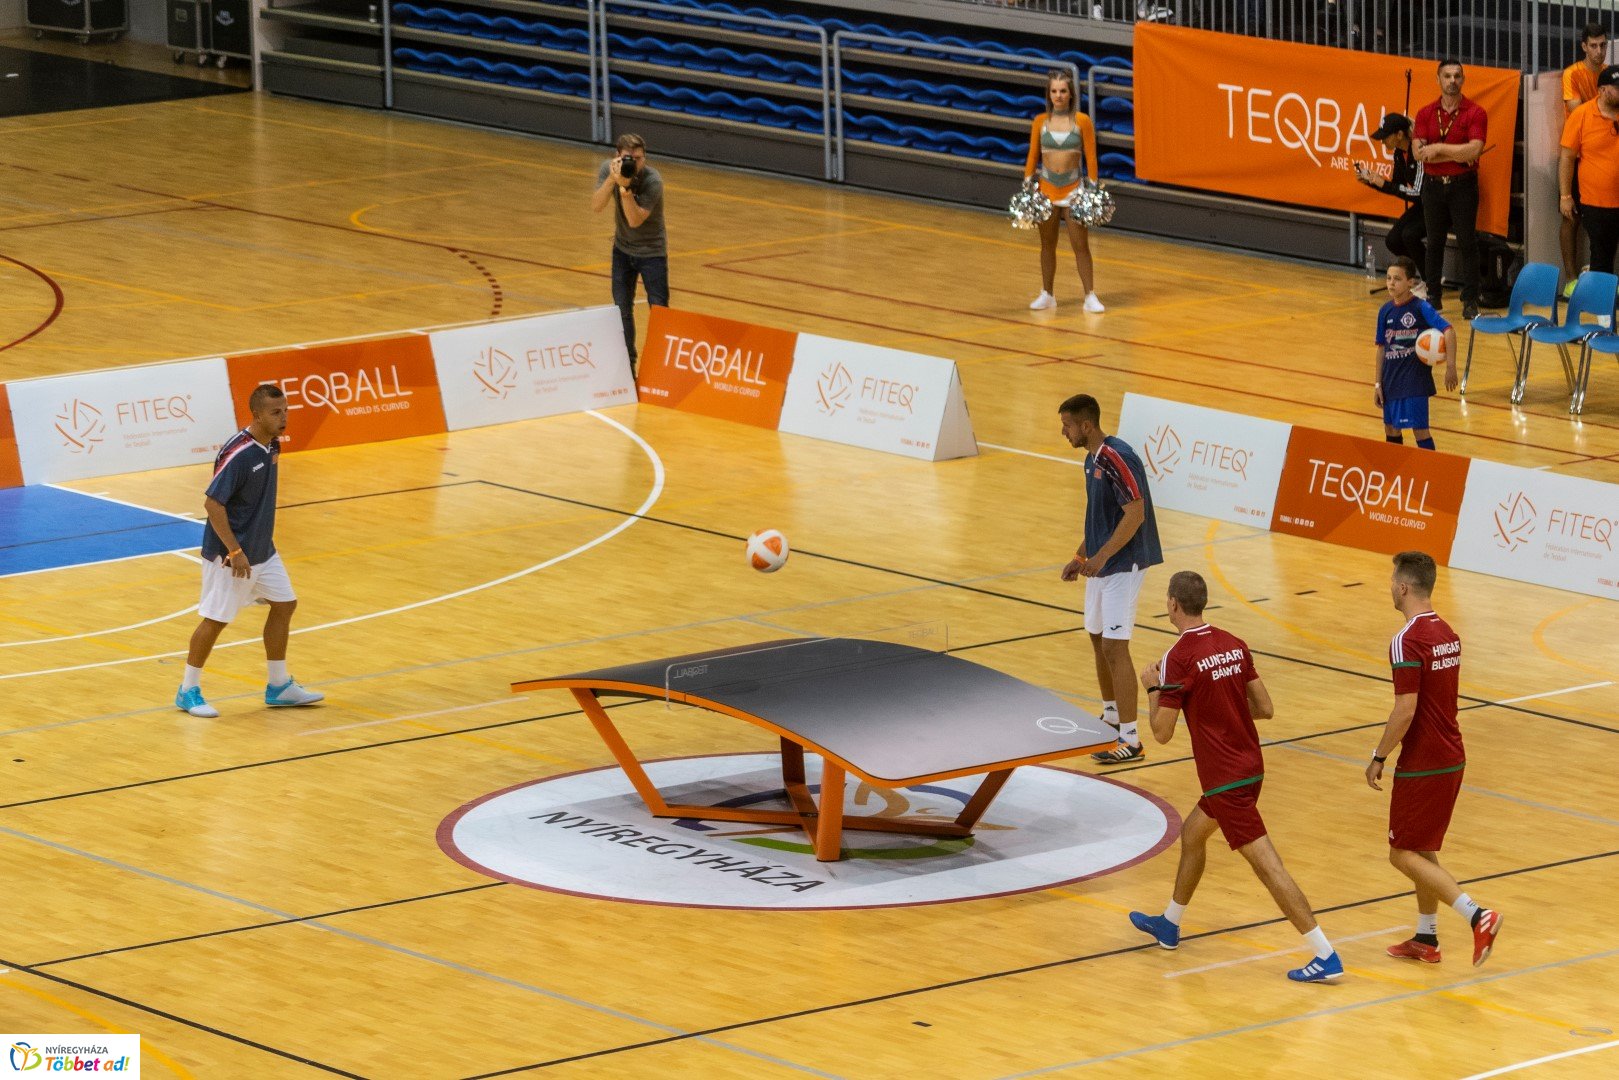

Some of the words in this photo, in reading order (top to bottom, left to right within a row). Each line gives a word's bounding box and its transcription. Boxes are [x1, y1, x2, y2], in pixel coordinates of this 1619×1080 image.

[1218, 83, 1394, 167] TEQBAL
[1330, 156, 1349, 171] ARE
[526, 342, 596, 372] FITEQ
[664, 334, 767, 385] TEQBALL
[116, 396, 196, 425] FITEQ
[345, 405, 373, 416] WORLD
[373, 404, 380, 413] IS
[381, 401, 410, 412] CURVED
[861, 376, 913, 415] FITEQ
[1191, 441, 1247, 481] FITEQ
[1309, 459, 1433, 516] TEQBALL
[1369, 510, 1392, 524] WORLD
[1392, 515, 1400, 525] IS
[1400, 517, 1426, 531] CURVED
[1548, 509, 1611, 551] FITEQ
[1197, 649, 1244, 672] HUNGARY
[1432, 641, 1460, 657] HUNGAR
[529, 811, 826, 892] NYÍREGYHÁZA
